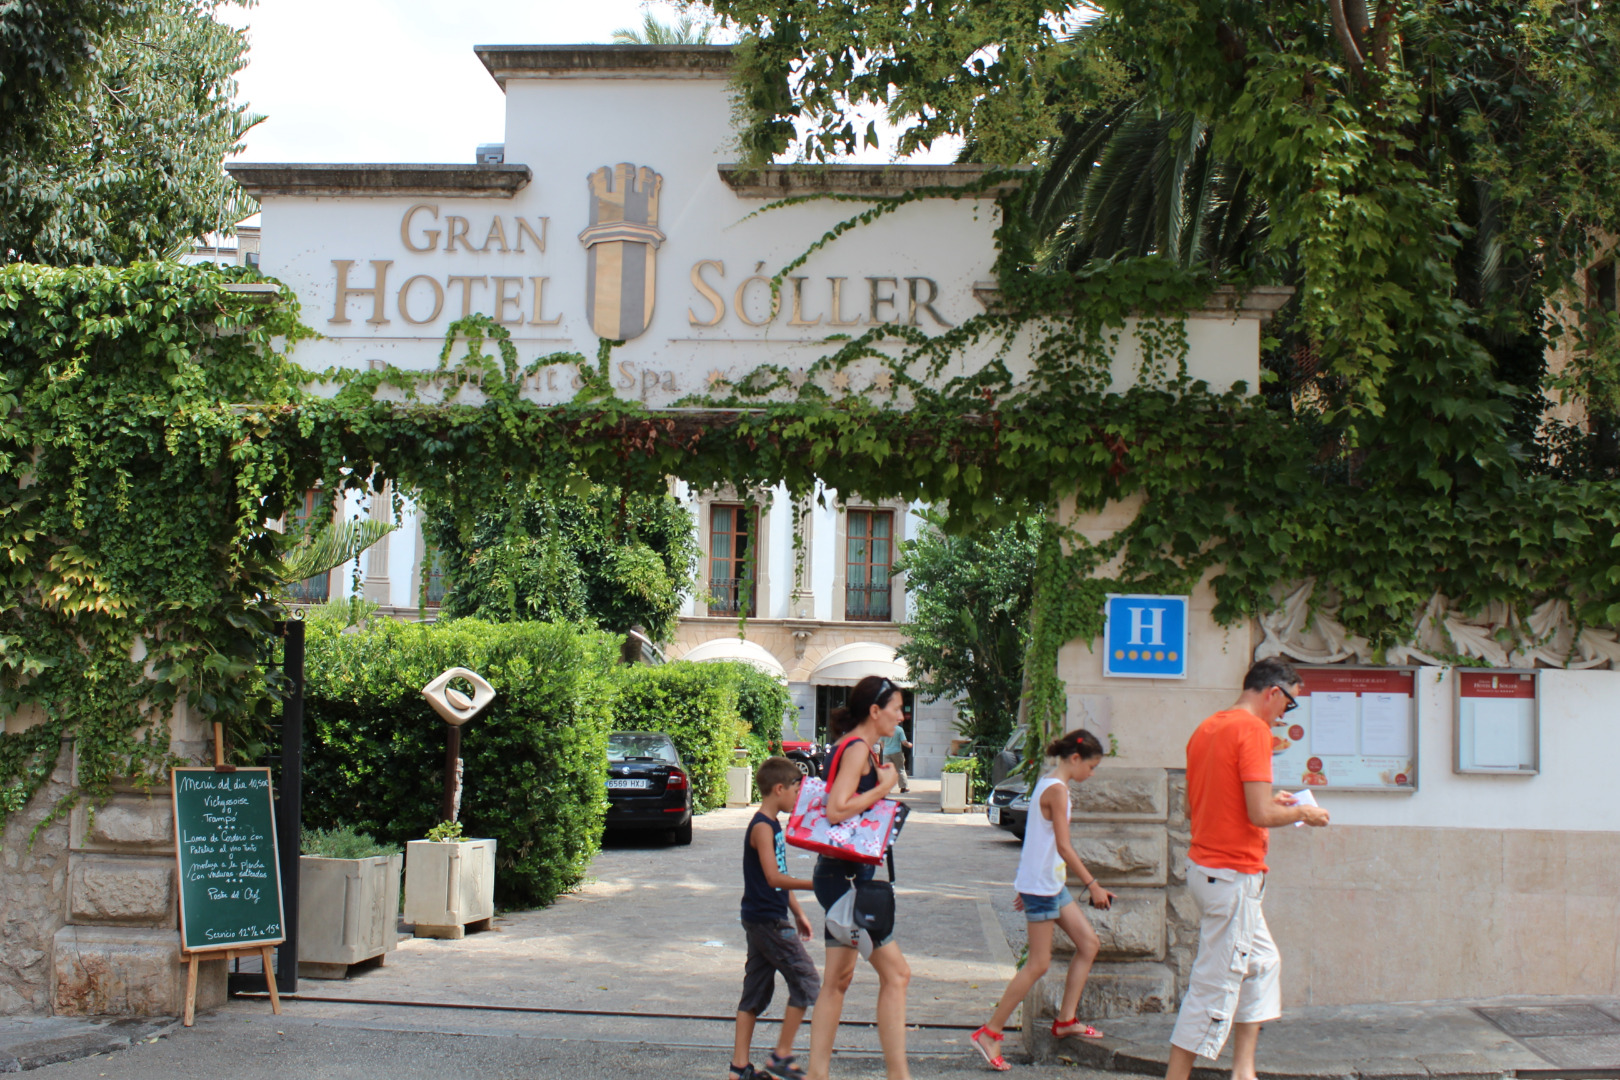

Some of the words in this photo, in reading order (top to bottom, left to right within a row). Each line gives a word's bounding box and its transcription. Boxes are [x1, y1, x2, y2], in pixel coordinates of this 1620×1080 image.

[400, 203, 550, 252] GRAN
[327, 259, 563, 326] HOTEL
[688, 260, 954, 327] SÓLLER
[617, 360, 678, 402] Spa
[1126, 607, 1166, 646] H
